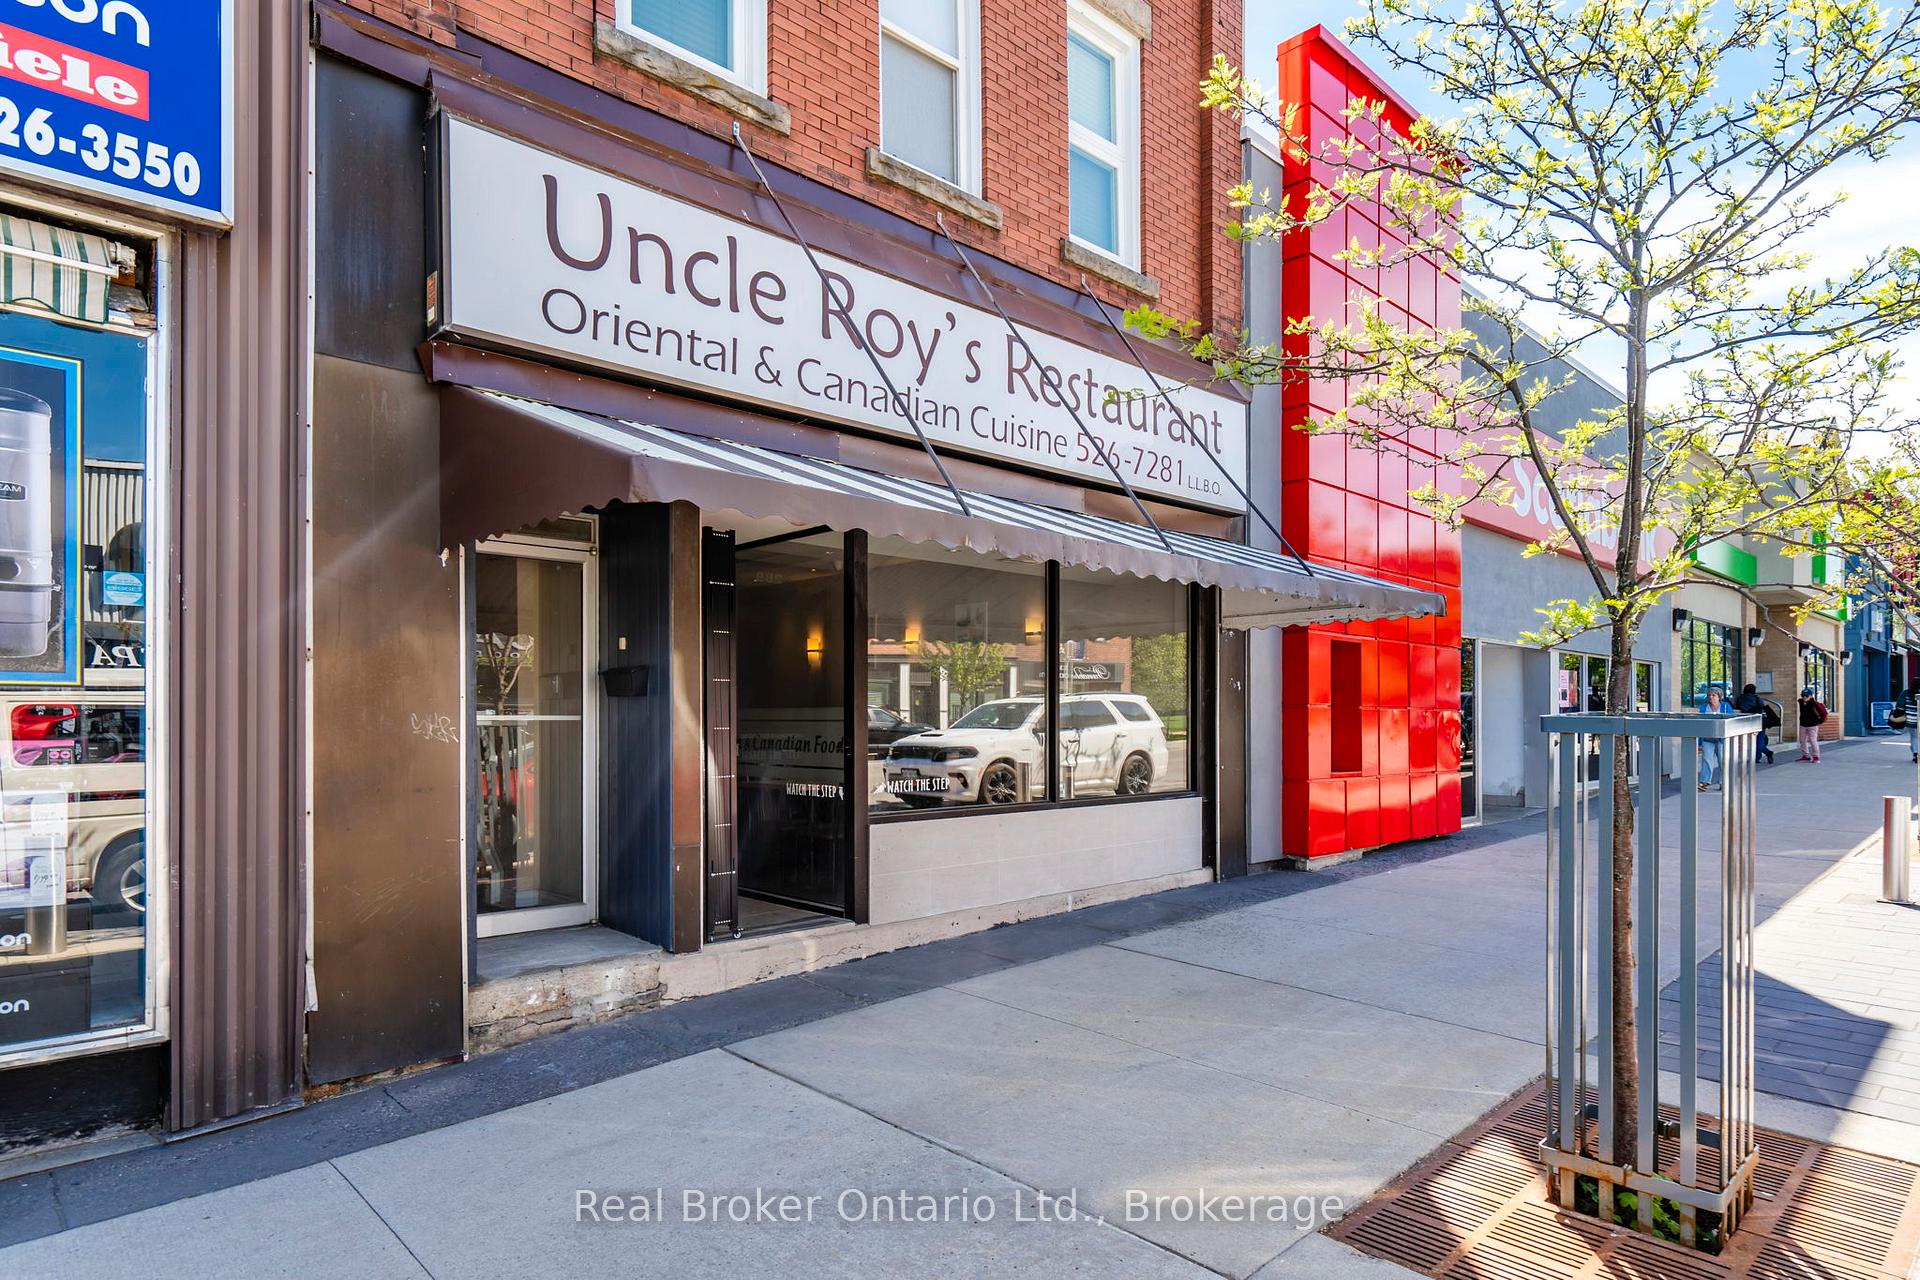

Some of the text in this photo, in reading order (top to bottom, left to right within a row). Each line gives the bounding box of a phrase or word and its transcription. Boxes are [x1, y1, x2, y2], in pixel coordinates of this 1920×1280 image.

[10, 0, 150, 47] on
[0, 96, 201, 197] 26-3550
[542, 173, 1223, 455] Uncle Roy's Restaurant
[542, 288, 1222, 496] Oriental & Canadian Cuisine 526-7281 L.L.B.O.
[786, 782, 837, 798] WATCH THE STEP
[887, 777, 950, 794] WATCH THE STEP
